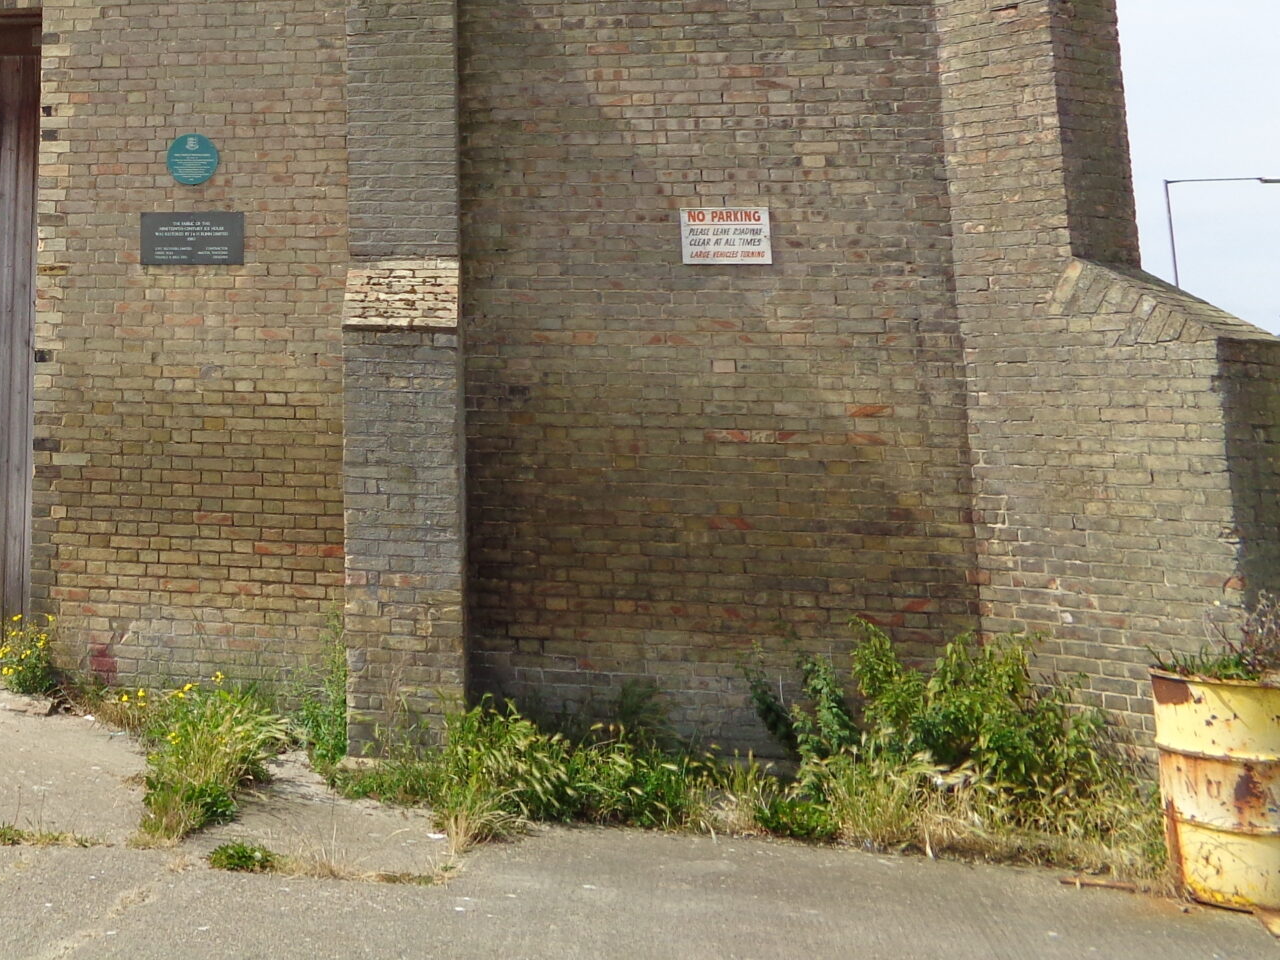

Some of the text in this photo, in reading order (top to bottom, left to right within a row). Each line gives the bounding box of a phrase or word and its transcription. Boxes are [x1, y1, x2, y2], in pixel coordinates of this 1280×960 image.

[687, 211, 761, 222] NO PARKING
[689, 228, 709, 236] PLEASE
[712, 228, 730, 236] LEAVE
[689, 238, 761, 246] CLEAR AT ALL TIMES
